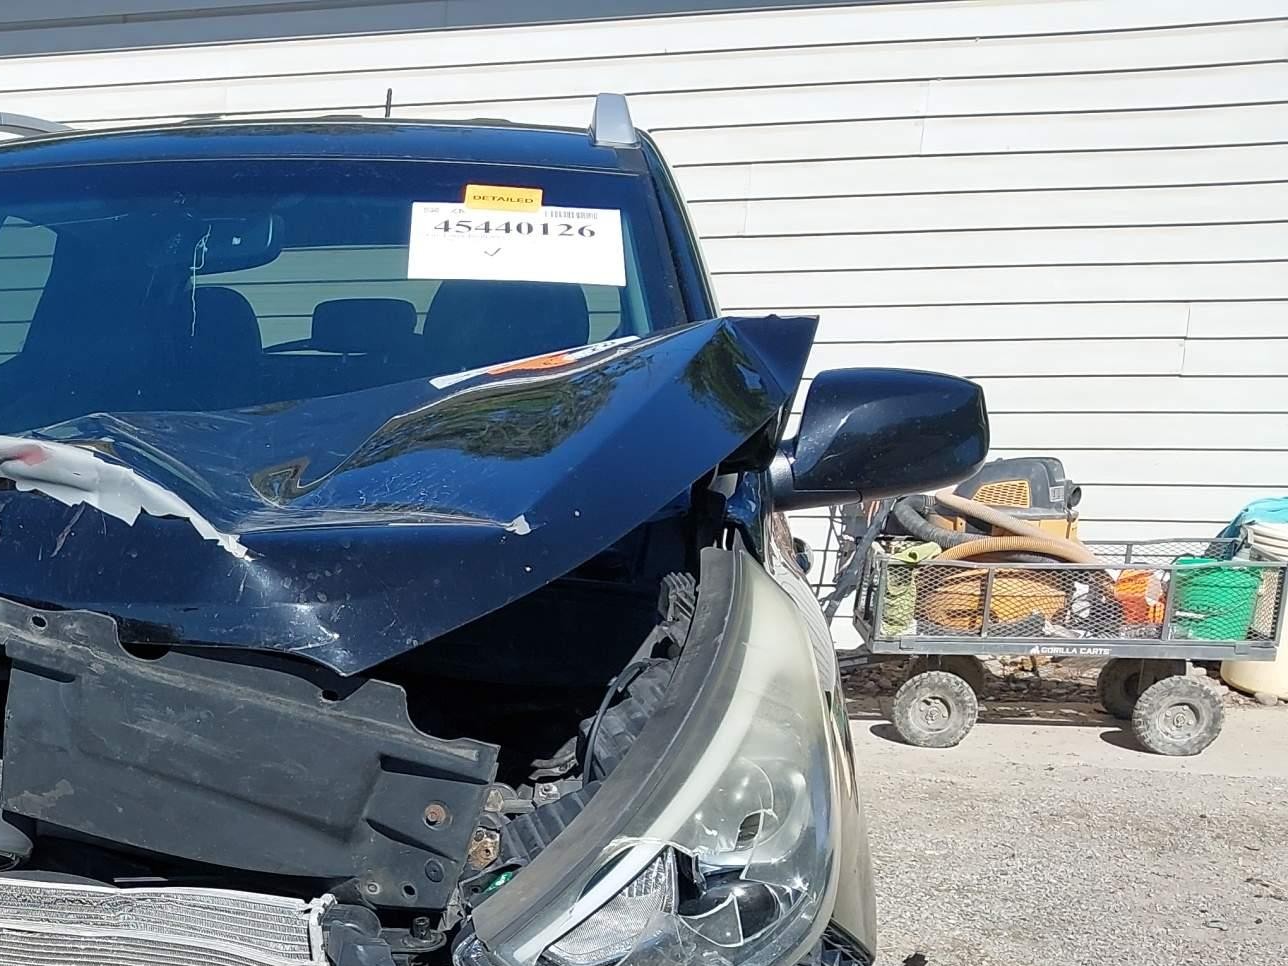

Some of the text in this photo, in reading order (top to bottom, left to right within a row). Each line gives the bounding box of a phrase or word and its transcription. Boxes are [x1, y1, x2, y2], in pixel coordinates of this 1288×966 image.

[472, 194, 534, 204] DETAILED
[433, 219, 596, 238] 45440126
[1041, 646, 1110, 655] GORILLA CARTS
